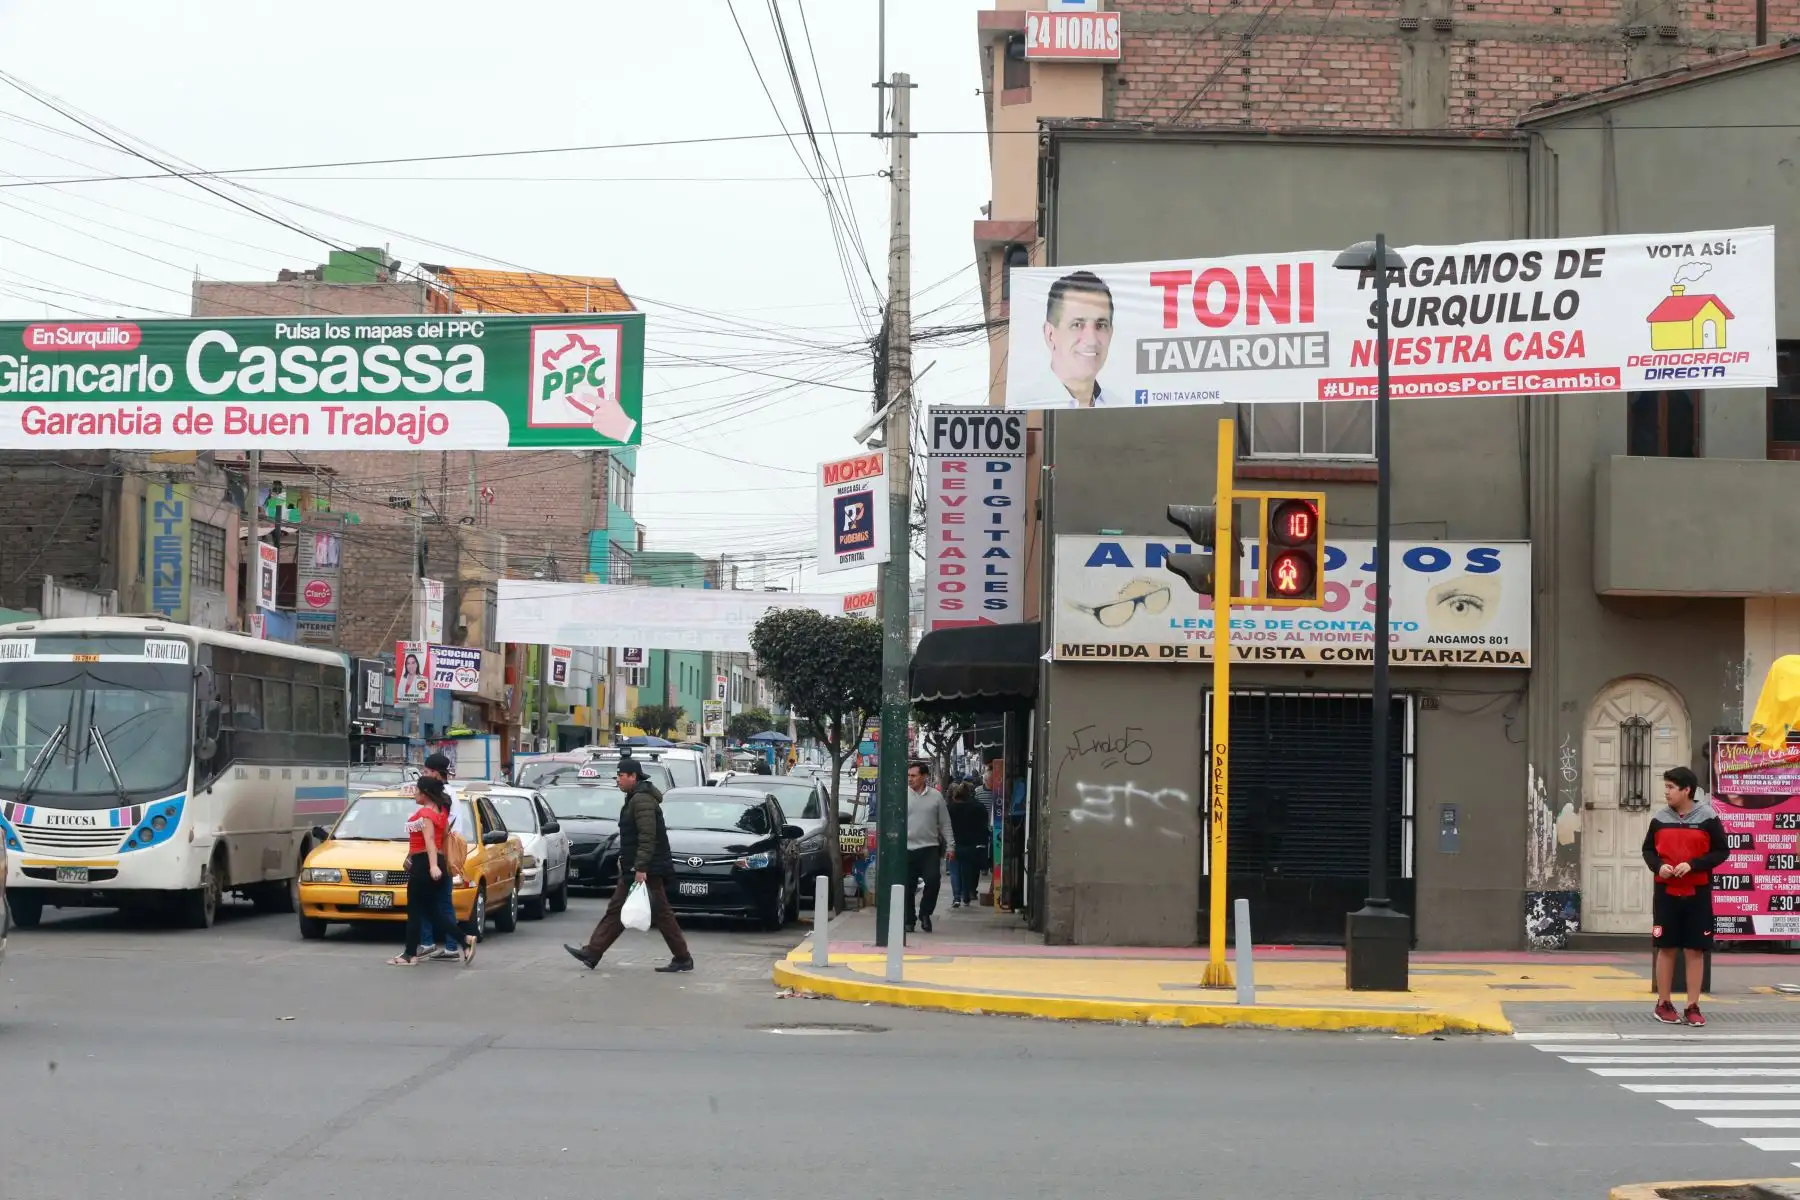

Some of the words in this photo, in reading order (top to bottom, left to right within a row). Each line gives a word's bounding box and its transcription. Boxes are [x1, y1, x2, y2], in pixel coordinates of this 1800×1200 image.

[1028, 16, 1050, 49] 24
[1055, 17, 1118, 51] HORAS
[1646, 243, 1695, 259] VOTA
[1554, 247, 1606, 280] DE
[1149, 262, 1315, 329] TONI
[275, 323, 320, 340] Pulsa
[325, 322, 350, 339] los
[355, 325, 412, 343] mapas
[417, 321, 443, 339] del
[448, 320, 485, 338] PPC
[1142, 335, 1325, 371] TAVARONE
[1503, 329, 1586, 362] CASA
[0, 354, 174, 394] Giancarlo
[186, 330, 485, 395] Casassa
[1626, 351, 1750, 367] DEMOCRACIA
[542, 356, 606, 401] PPC
[1644, 365, 1726, 381] DIRECTA
[1152, 392, 1172, 401] TONI
[1174, 390, 1220, 401] TAVARONE
[21, 405, 162, 435] Garantia
[172, 405, 214, 435] de
[224, 405, 309, 435] Buen
[320, 405, 449, 445] Trabajo
[933, 416, 1021, 451] FOTOS
[824, 456, 881, 484] MORA
[937, 461, 968, 611] REVELADOS
[982, 461, 1012, 611] DIGITALES
[1290, 513, 1308, 537] 10
[153, 483, 184, 617] INTERNET
[839, 551, 865, 564] DISTRITAL
[306, 589, 327, 598] Claro
[843, 593, 875, 610] MORA
[297, 623, 336, 631] INTERNET
[1170, 618, 1257, 630] LENES
[1265, 619, 1294, 630] DE
[1298, 620, 1420, 632] CONTATO
[1184, 630, 1278, 641] TRAAJOS
[1285, 632, 1304, 642] AL
[1309, 632, 1400, 643] MOMENO
[1427, 635, 1486, 645] ANGAMOS
[1489, 635, 1509, 645] 801
[145, 643, 188, 660] SURQUILLO
[1062, 643, 1149, 658] MEDIDA
[1159, 645, 1189, 659] DE
[1237, 646, 1306, 660] VISTA
[1320, 647, 1526, 665] COMUTARIZADA
[582, 769, 596, 777] TAXI
[47, 815, 96, 826] ETUCCSA
